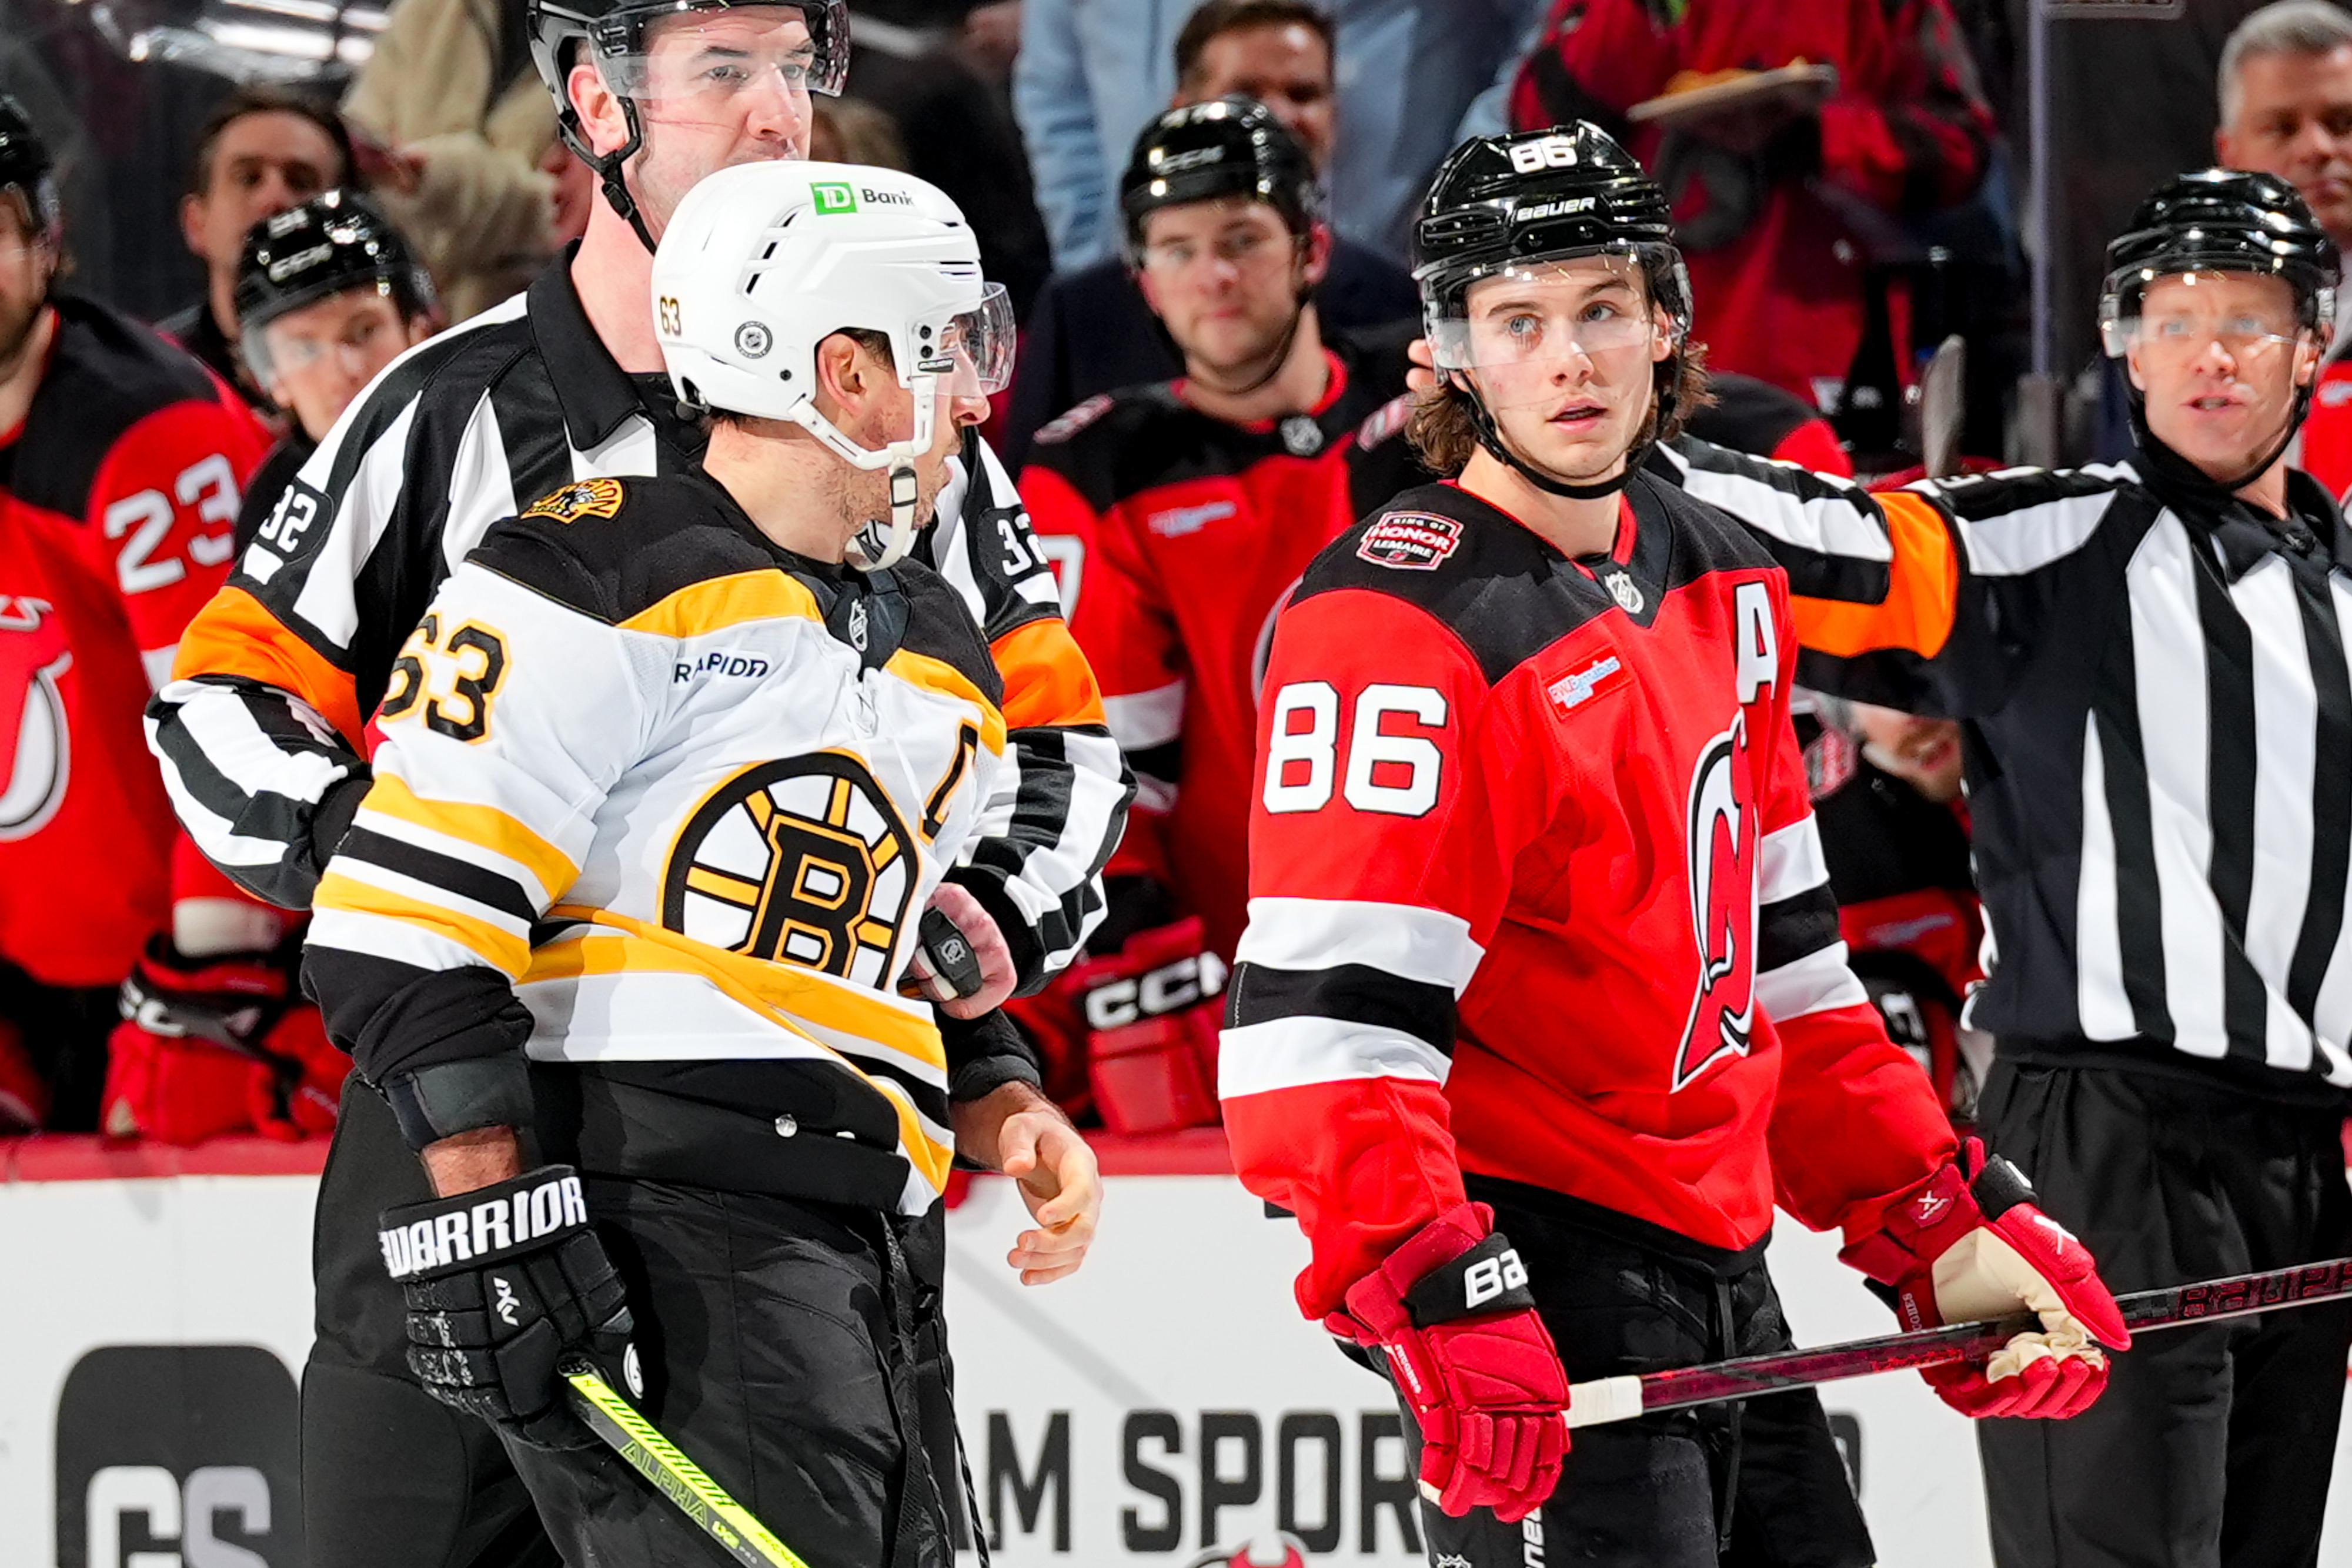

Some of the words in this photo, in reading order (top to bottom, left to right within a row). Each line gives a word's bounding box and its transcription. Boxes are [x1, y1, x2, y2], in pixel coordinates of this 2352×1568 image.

[814, 185, 852, 209] TD
[861, 188, 915, 206] Bank
[1509, 136, 1578, 173] 86
[1516, 197, 1596, 222] BAUER
[660, 296, 681, 336] 63
[105, 453, 240, 594] 23
[259, 484, 318, 553] 32
[1370, 526, 1451, 551] HONOR
[1372, 539, 1434, 559] LEMAIRE
[375, 611, 512, 745] 63
[1733, 580, 1778, 704] A
[1262, 680, 1449, 819] 86
[747, 813, 877, 979] B
[379, 1176, 587, 1279] WARRIOR
[1902, 1293, 1923, 1332] UGHES
[86, 1465, 272, 1568] GS
[619, 1440, 707, 1530] ALPHA
[1122, 1411, 1423, 1553] SPOR
